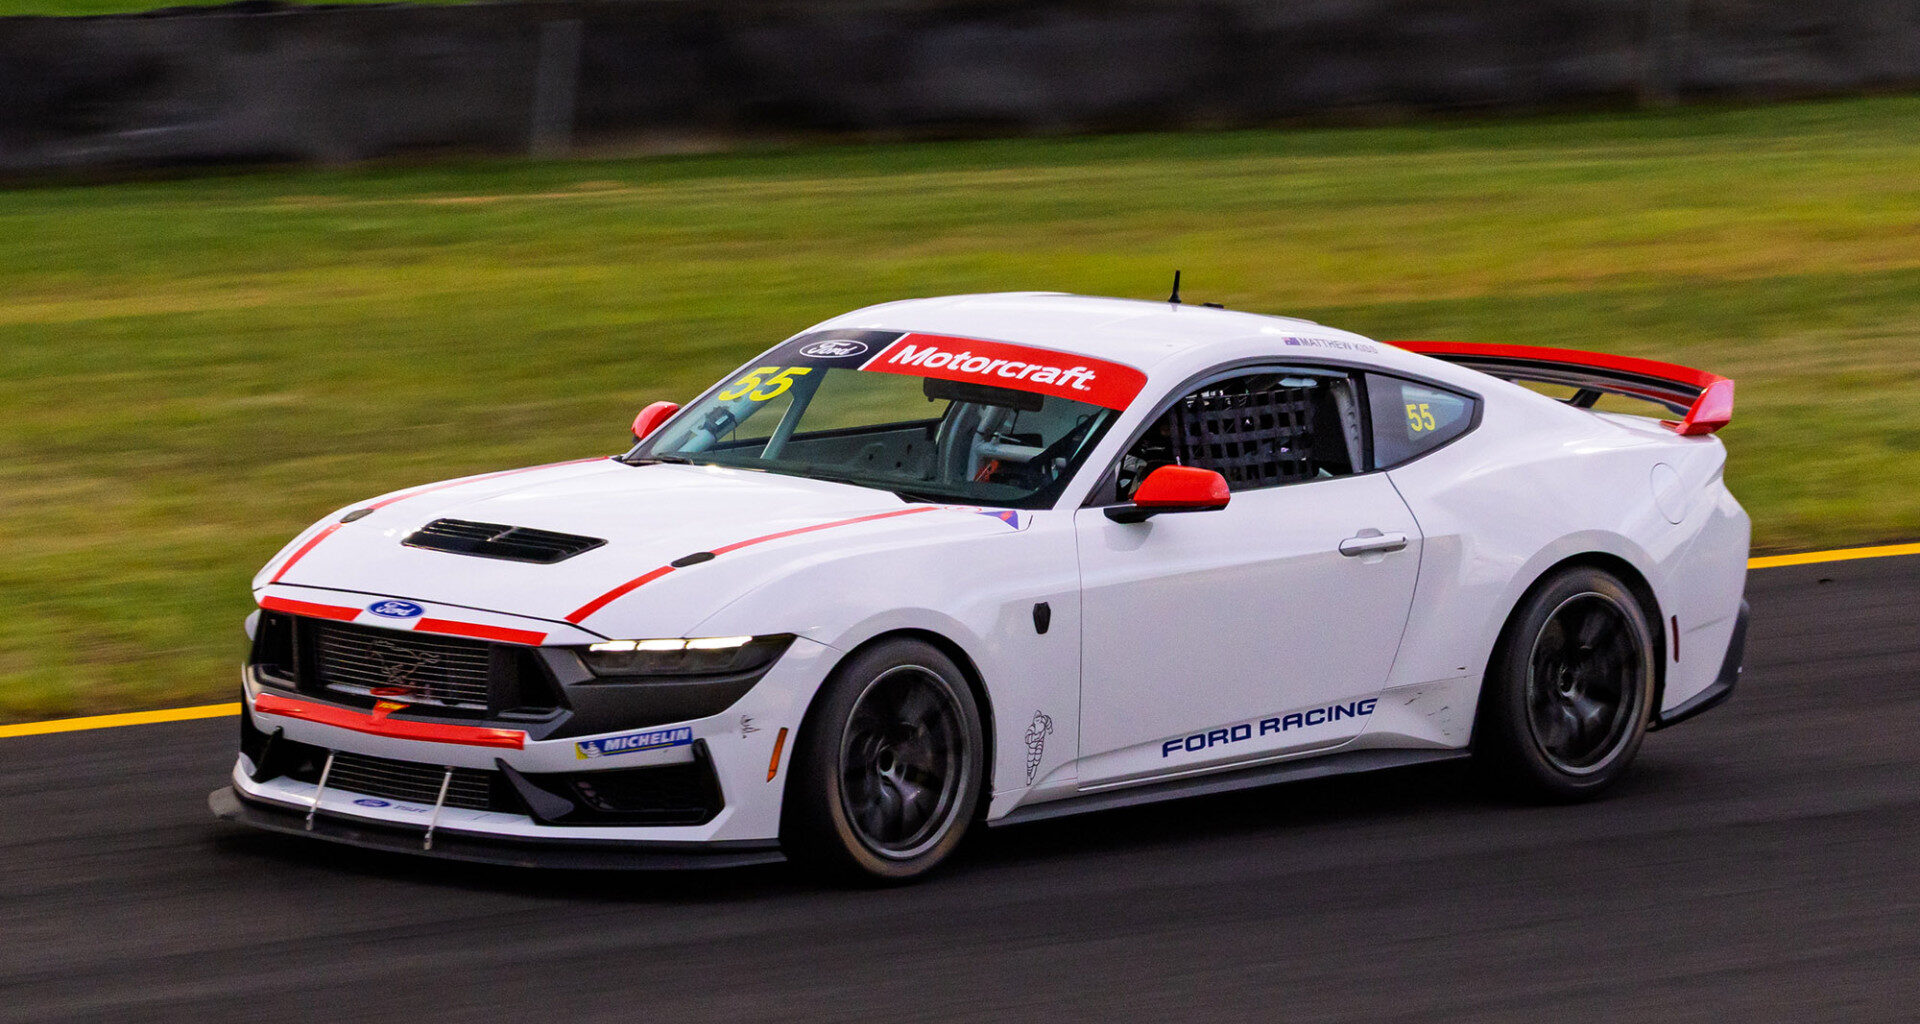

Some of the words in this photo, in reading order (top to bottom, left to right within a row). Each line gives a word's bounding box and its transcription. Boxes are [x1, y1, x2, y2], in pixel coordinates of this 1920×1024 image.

[807, 341, 858, 356] Ford
[1298, 337, 1352, 350] MATTHEW
[888, 344, 1096, 390] Motorcraft
[718, 366, 813, 402] 55
[1406, 403, 1435, 432] 55
[604, 728, 690, 751] MICHELIN
[1162, 723, 1252, 758] FORD
[1259, 698, 1379, 736] RACING
